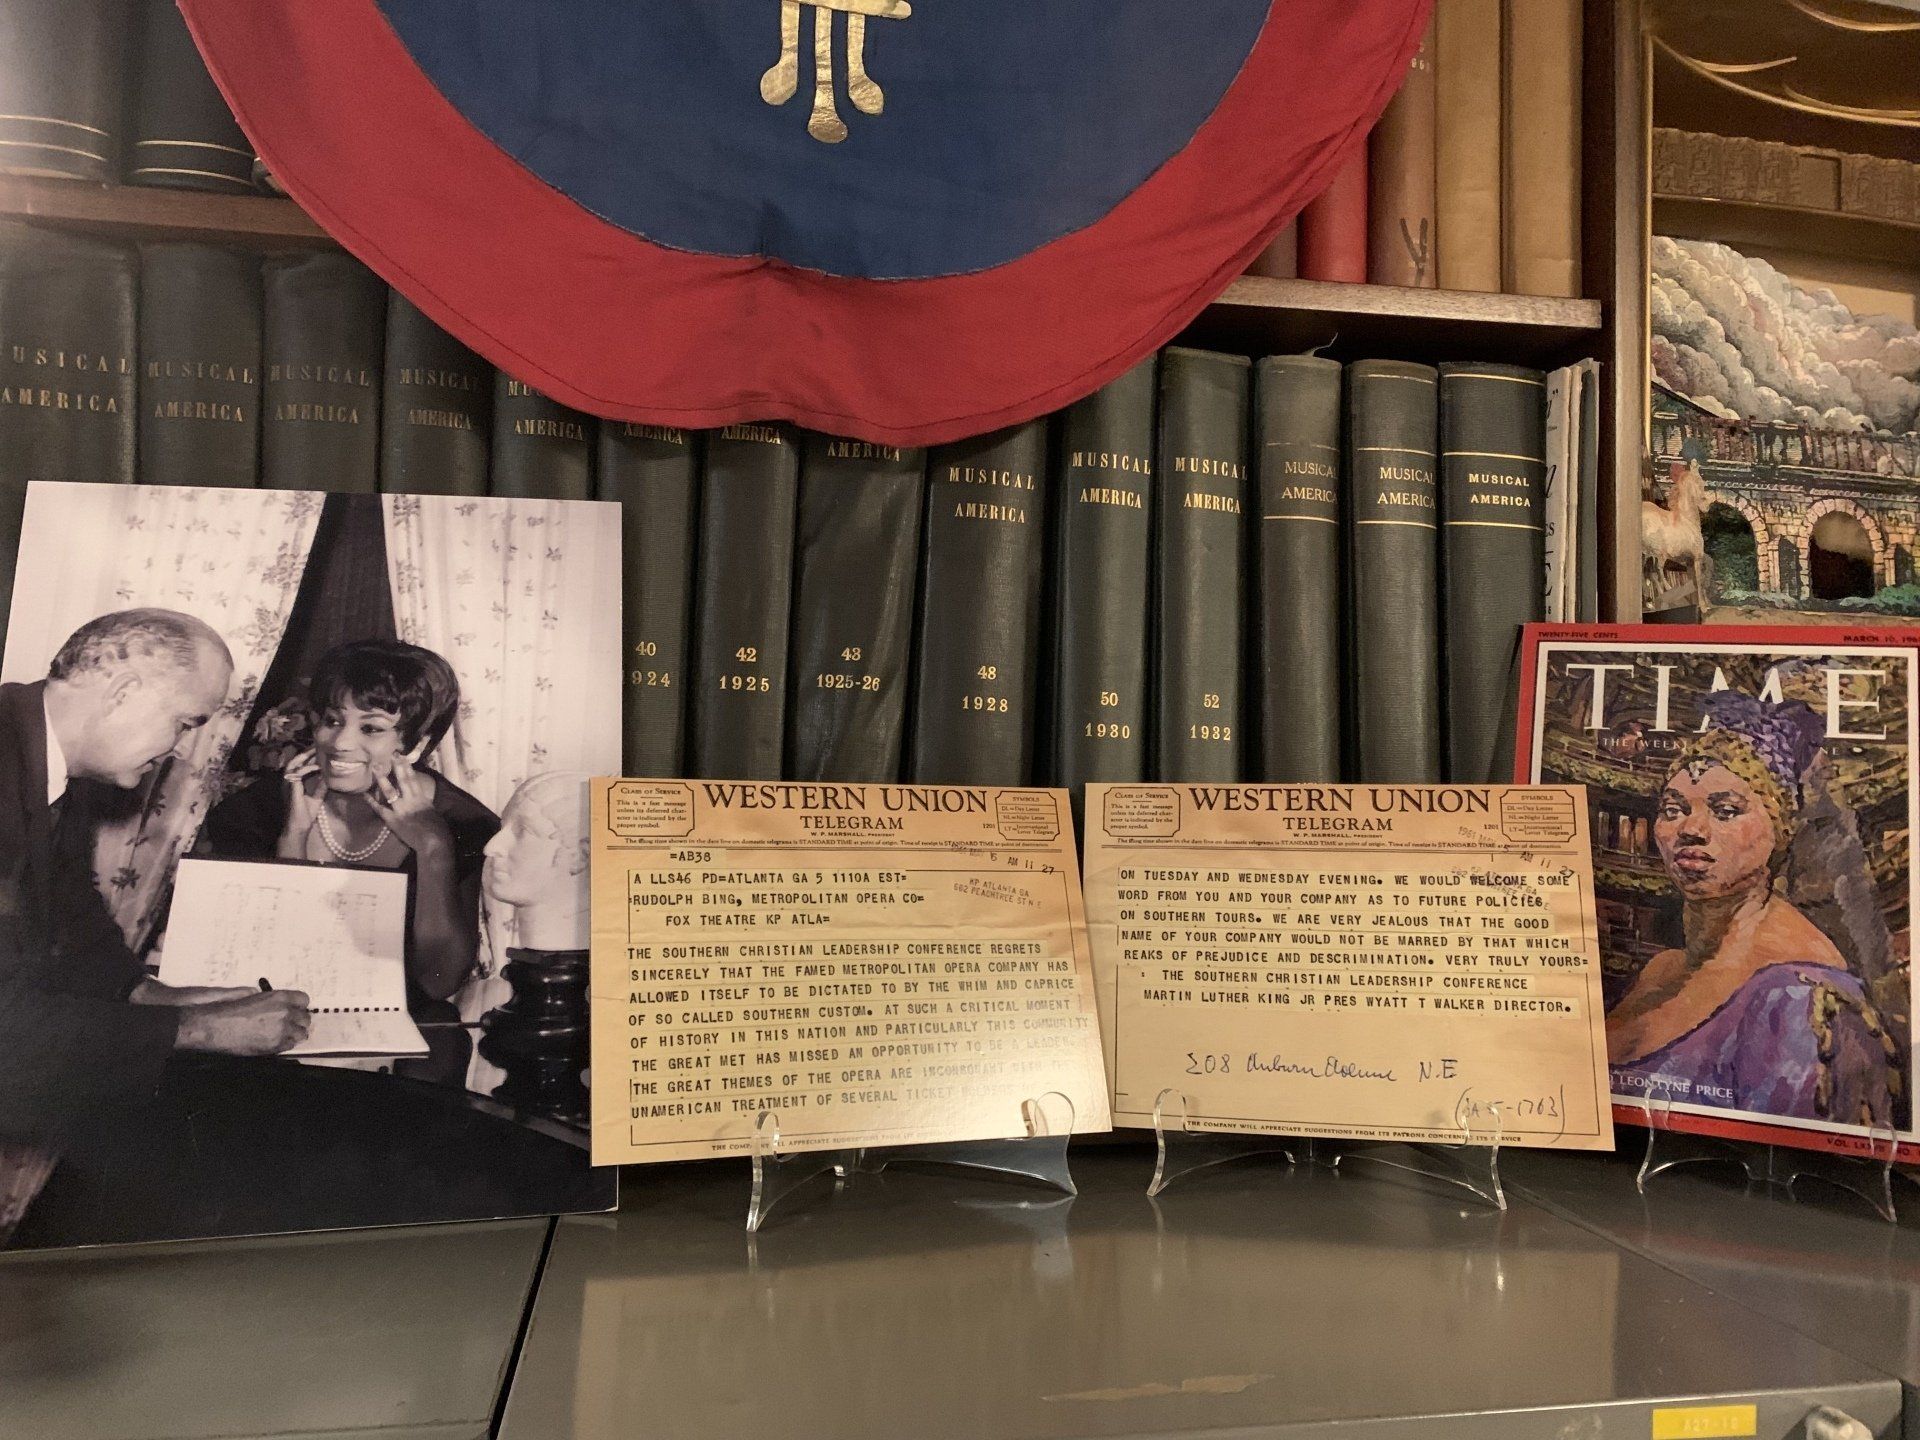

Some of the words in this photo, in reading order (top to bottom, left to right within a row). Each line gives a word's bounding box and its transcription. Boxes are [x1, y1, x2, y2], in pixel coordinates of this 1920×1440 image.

[149, 362, 253, 385] MUSICAL
[270, 364, 370, 387] MUSICAL
[399, 368, 478, 391] MUSICA
[1, 387, 118, 413] AMERICA
[154, 402, 244, 423] AMERICA
[274, 404, 359, 424] AMERICA
[409, 409, 472, 430] AMERICA
[514, 419, 584, 441] AMERICA
[721, 424, 782, 445] AMERICA
[827, 441, 901, 463] AMERICA
[1072, 451, 1151, 475] MUSICAL
[1175, 457, 1248, 480] MUSICAL
[949, 467, 1035, 490] MUSICAL
[1379, 466, 1436, 484] MUSICAL
[1469, 473, 1530, 487] MUSICAL
[1079, 488, 1142, 509] AMERICA
[1184, 493, 1241, 514] AMERICA
[1377, 492, 1437, 509] AMERICA
[1470, 494, 1532, 508] AMERICA
[954, 502, 1026, 524] AMERICA
[1537, 630, 1589, 639] TWENTY-FIVE
[635, 641, 656, 656] 40
[735, 647, 757, 662] 42
[841, 647, 861, 661] 43
[977, 665, 997, 680] 48
[719, 675, 770, 692] 1925
[816, 674, 881, 691] 1925-26
[962, 695, 1008, 712] 1928
[1100, 691, 1119, 707] 50
[1203, 694, 1220, 709] 52
[1085, 723, 1130, 739] 1930
[1190, 724, 1231, 741] 1932
[1602, 737, 1629, 747] THE
[703, 784, 866, 811] WESTERN
[880, 787, 988, 813] UNION
[1188, 787, 1352, 812] WESTERN
[1368, 788, 1491, 813] UNION
[800, 815, 903, 830] TELEGRAM
[1282, 817, 1392, 831] TELEGRAM
[1145, 871, 1198, 881] TUESDAY
[1239, 873, 1308, 883] WEDNESDAY
[1320, 875, 1382, 884] EVENING.
[1420, 876, 1460, 885] WOULD
[1538, 875, 1569, 886] SOME
[752, 893, 847, 904] METROPOLITAN
[857, 893, 894, 903] OPERA
[1118, 890, 1148, 900] WORD
[1158, 891, 1186, 900] FROM
[1229, 892, 1251, 902] AND
[1261, 893, 1291, 903] YOUR
[1301, 894, 1356, 904] COMPANY
[1419, 896, 1466, 906] FUTURE
[700, 915, 755, 925] THEATRE
[1144, 911, 1205, 921] SOUTHERN
[1216, 912, 1261, 922] TOURS.
[1298, 914, 1319, 924] ARE
[1331, 915, 1361, 925] VERY
[1372, 916, 1428, 926] JEALOUS
[1439, 917, 1471, 927] THAT
[1481, 918, 1504, 928] THE
[1515, 918, 1548, 929] GOOD
[1122, 931, 1151, 940] NAME
[1186, 932, 1216, 942] YOUR
[1226, 933, 1281, 943] COMPANY
[1292, 934, 1330, 944] WOULD
[1340, 935, 1364, 945] NOT
[1398, 936, 1447, 946] MARRED
[1483, 937, 1516, 947] THAT
[1526, 939, 1568, 948] WHICH
[628, 948, 651, 959] THE
[663, 946, 728, 958] SOUTHERN
[740, 945, 812, 956] CHRISTIAN
[823, 944, 899, 955] LEADERSHIP
[908, 944, 981, 954] CONFERENCE
[991, 944, 1040, 954] REGRETS
[1125, 950, 1162, 959] REAKS
[1197, 951, 1267, 962] PREJUDICE
[1278, 953, 1300, 962] AND
[1446, 955, 1478, 965] VERY
[1489, 956, 1528, 966] TRULY
[1540, 956, 1588, 966] YOURS=
[632, 968, 709, 981] SINCERELY
[720, 967, 752, 978] THAT
[763, 966, 784, 977] THE
[796, 965, 835, 976] FAMED
[843, 963, 935, 975] METROPOLITAN
[945, 962, 980, 973] OPERA
[988, 962, 1038, 972] COMPANY
[1048, 961, 1068, 971] HAS
[1163, 970, 1183, 980] THE
[1195, 971, 1257, 982] SOUTHERN
[1266, 973, 1339, 984] CHRISTIAN
[1351, 975, 1432, 987] LEADERSHIP
[1444, 977, 1527, 989] CONFERENCE
[630, 991, 688, 1003] ALLOWED
[702, 988, 749, 1000] ITSELF
[809, 984, 871, 996] DICTATED
[1025, 979, 1073, 989] CAPRICE
[1144, 990, 1191, 1000] MARTIN
[1202, 992, 1248, 1002] LUTHER
[1258, 994, 1289, 1004] KING
[1325, 995, 1356, 1006] PRES
[1366, 997, 1407, 1007] WYATT
[1434, 999, 1484, 1009] WALKER
[1495, 1000, 1571, 1012] DIRECTOR.
[682, 1011, 733, 1023] CALLED
[744, 1008, 809, 1020] SOUTHERN
[908, 1004, 936, 1014] SUCH
[960, 1002, 1019, 1014] CRITICAL
[660, 1033, 718, 1046] HISTORY
[756, 1029, 788, 1041] THIS
[798, 1027, 845, 1038] NATION
[886, 1022, 977, 1035] PARTICULARLY
[669, 1056, 710, 1069] GREAT
[789, 1049, 838, 1062] MISSED
[872, 1043, 957, 1057] OPPORTUNITY
[668, 1079, 711, 1092] GREAT
[722, 1076, 772, 1089] THEMES
[842, 1070, 880, 1082] OPERA
[1619, 1074, 1690, 1094] LEONTYNE
[1696, 1085, 1734, 1099] PRICE
[632, 1102, 720, 1118] UNAMERICAN
[732, 1096, 806, 1111] TREATMENT
[842, 1091, 897, 1103] SEVERAL
[1203, 1121, 1237, 1129] COMPANY
[1261, 1124, 1301, 1132] APPRECIATE
[1305, 1127, 1352, 1135] SUGGESTIONS
